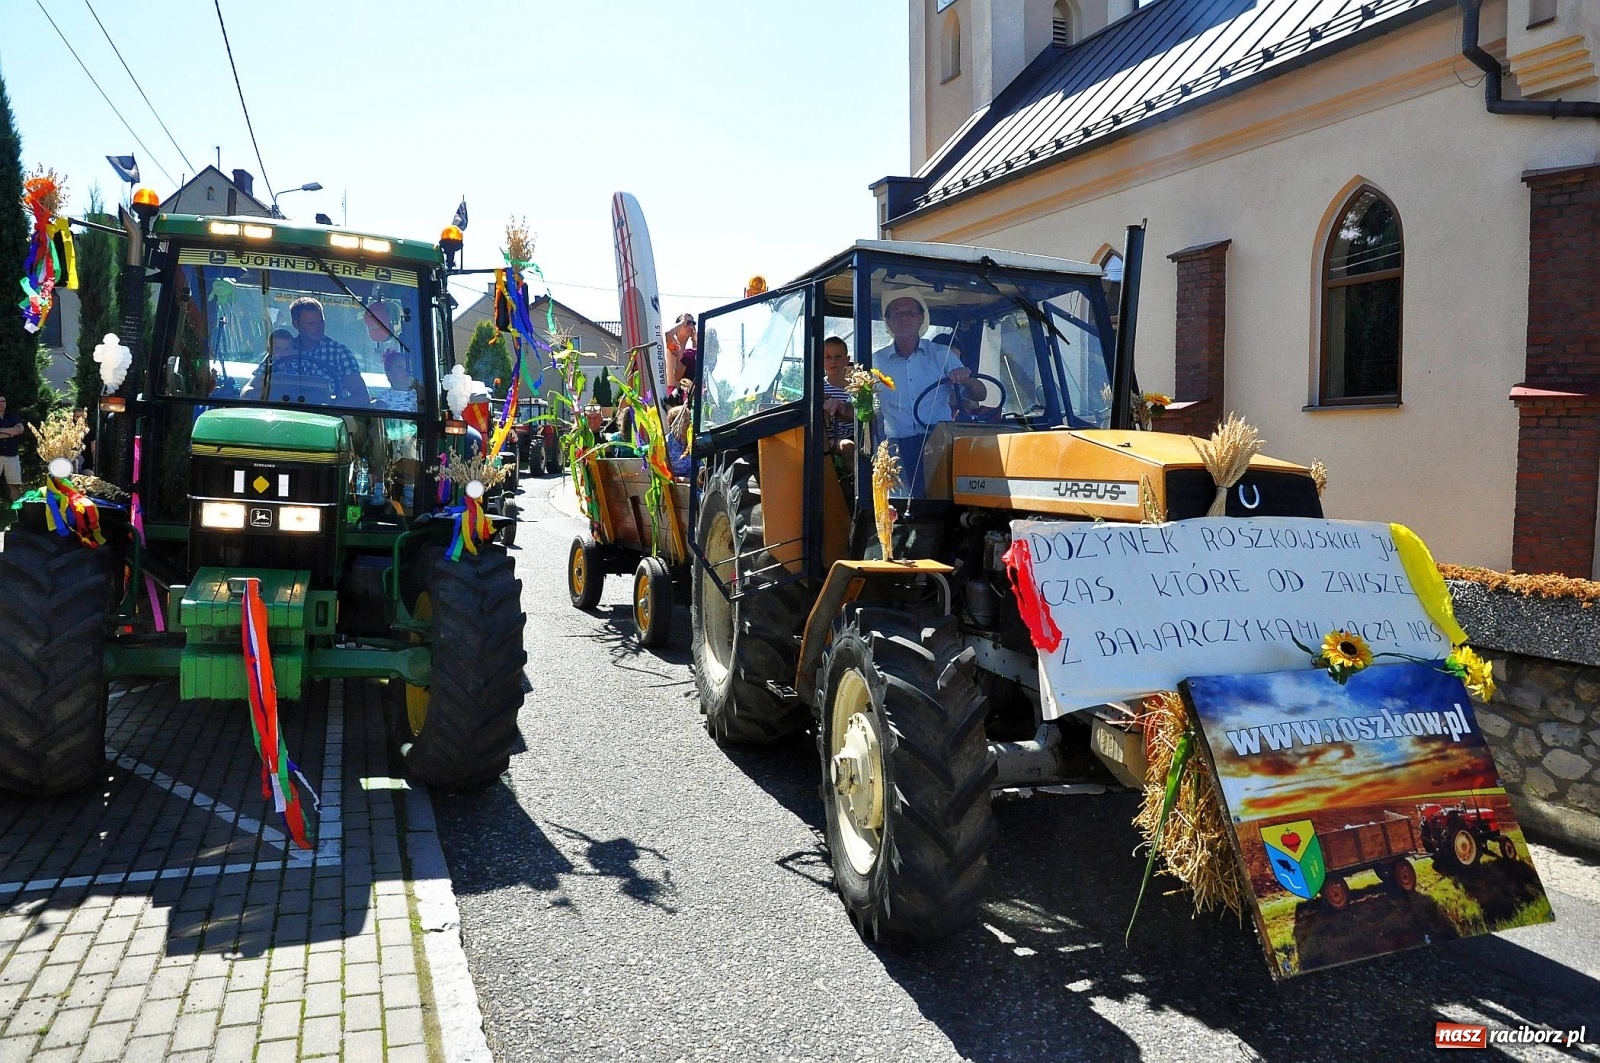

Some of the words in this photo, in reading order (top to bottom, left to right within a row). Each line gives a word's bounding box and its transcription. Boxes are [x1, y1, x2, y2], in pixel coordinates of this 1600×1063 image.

[240, 254, 296, 270] JOHN
[968, 479, 986, 490] 1014
[1053, 482, 1126, 500] URSUS
[1201, 526, 1361, 552] ROSZKOWSKICH
[1040, 576, 1122, 606] CZAS,
[1151, 563, 1250, 597] KTÓRE
[1268, 567, 1304, 593] OD
[1060, 638, 1081, 665] Z
[1095, 618, 1320, 656] BAWARCZYKAMI
[1406, 620, 1442, 643] NAS
[1226, 703, 1472, 757] www.roszkow.pl
